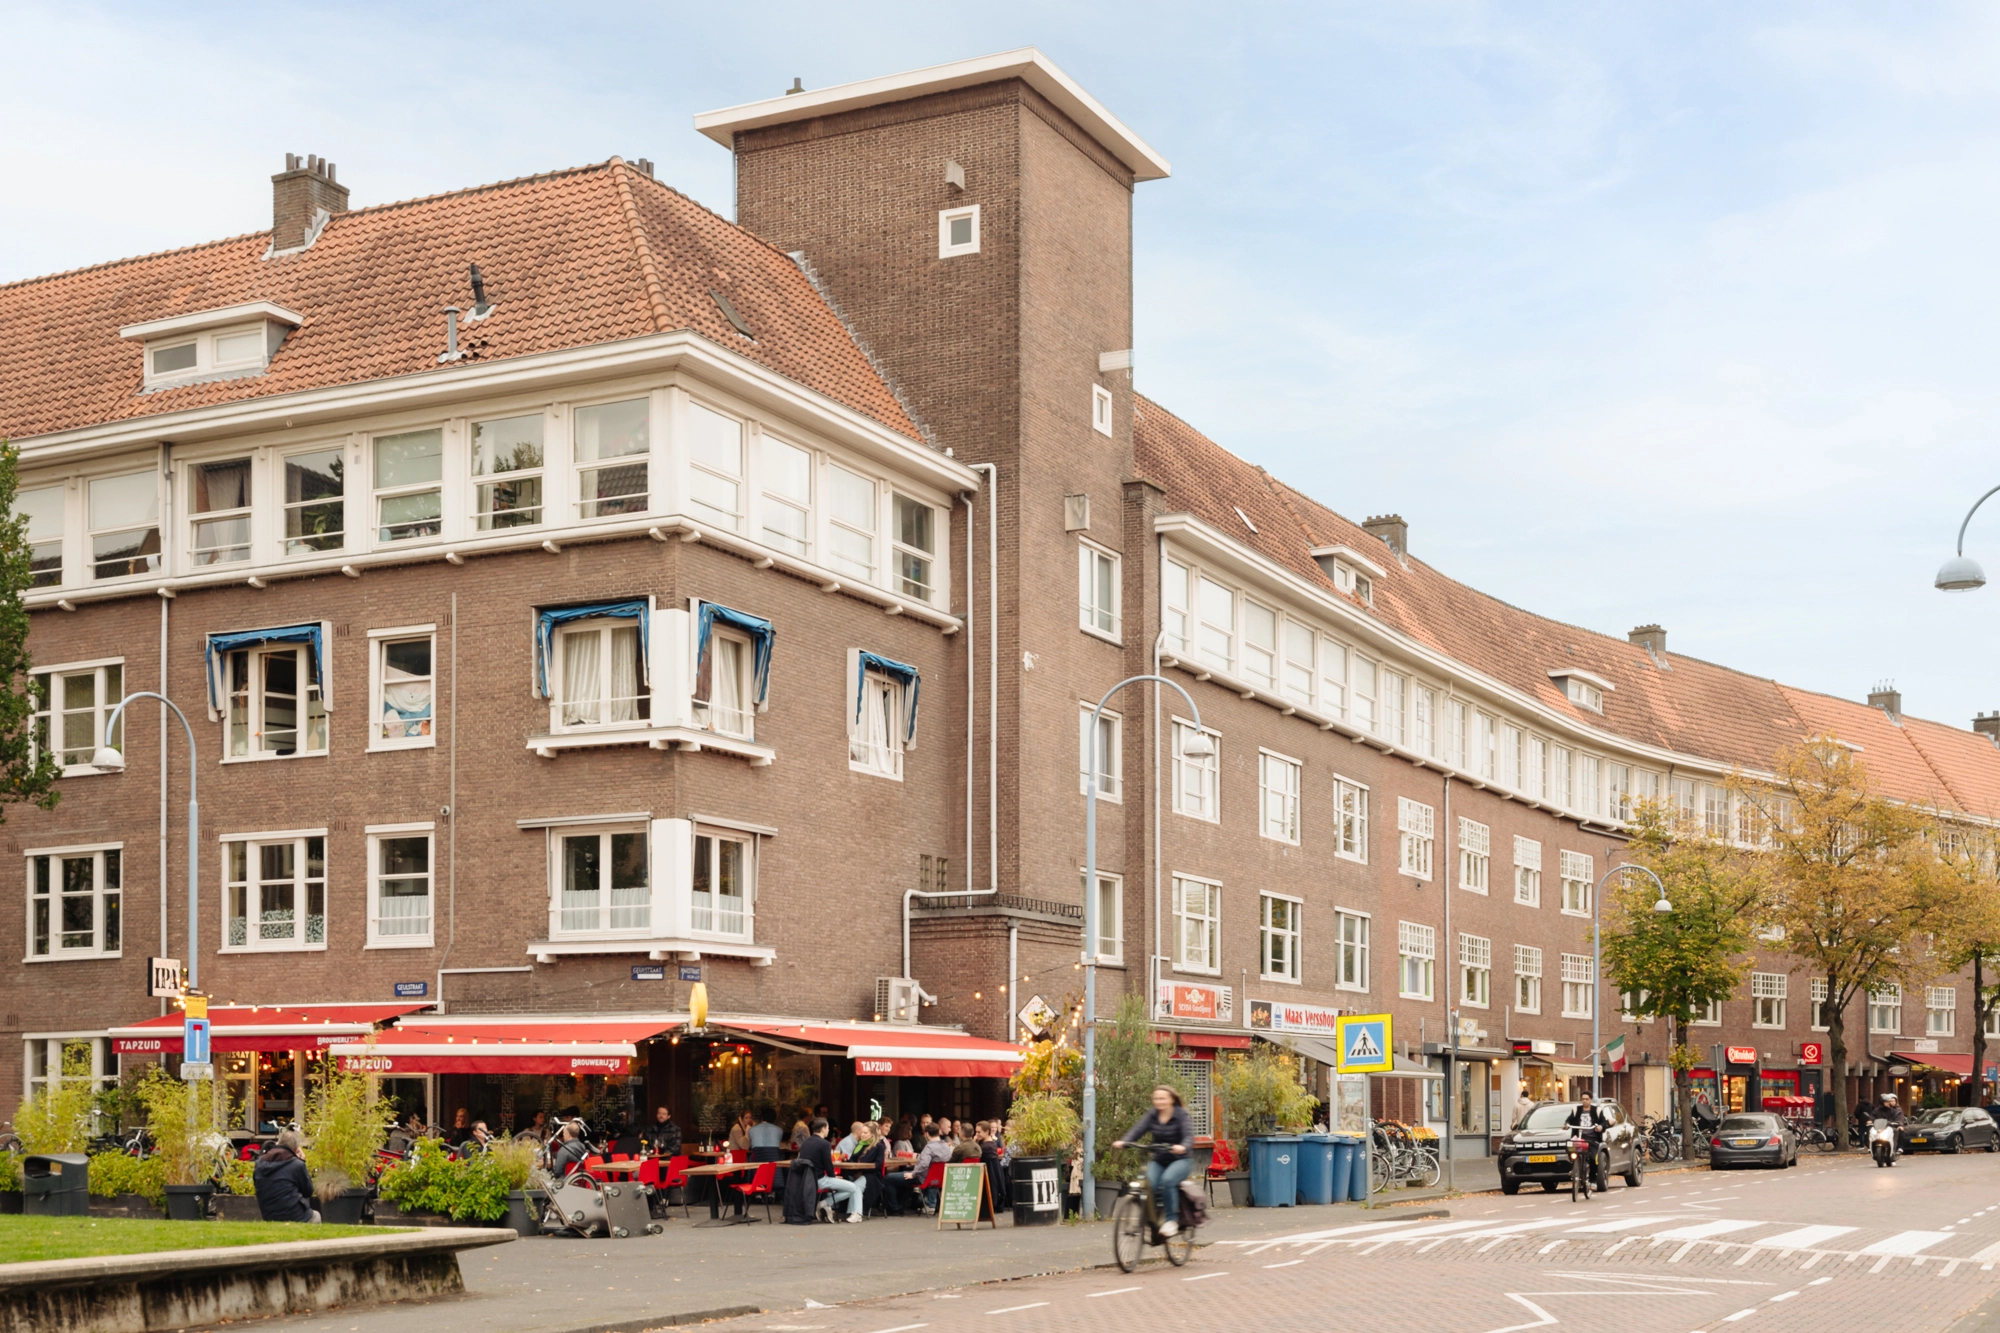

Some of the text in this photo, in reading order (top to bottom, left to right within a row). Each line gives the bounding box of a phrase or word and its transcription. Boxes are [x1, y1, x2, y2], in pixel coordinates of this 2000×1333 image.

[632, 966, 662, 975] GEULSTRAAT
[154, 967, 178, 989] IPA
[397, 983, 424, 991] GEULSTRAAT
[1284, 1007, 1302, 1025] Maas
[1305, 1010, 1335, 1030] Versshop
[120, 1041, 160, 1050] TAPZUID
[346, 1059, 393, 1070] TAPZUID
[861, 1061, 893, 1072] TAPZUID
